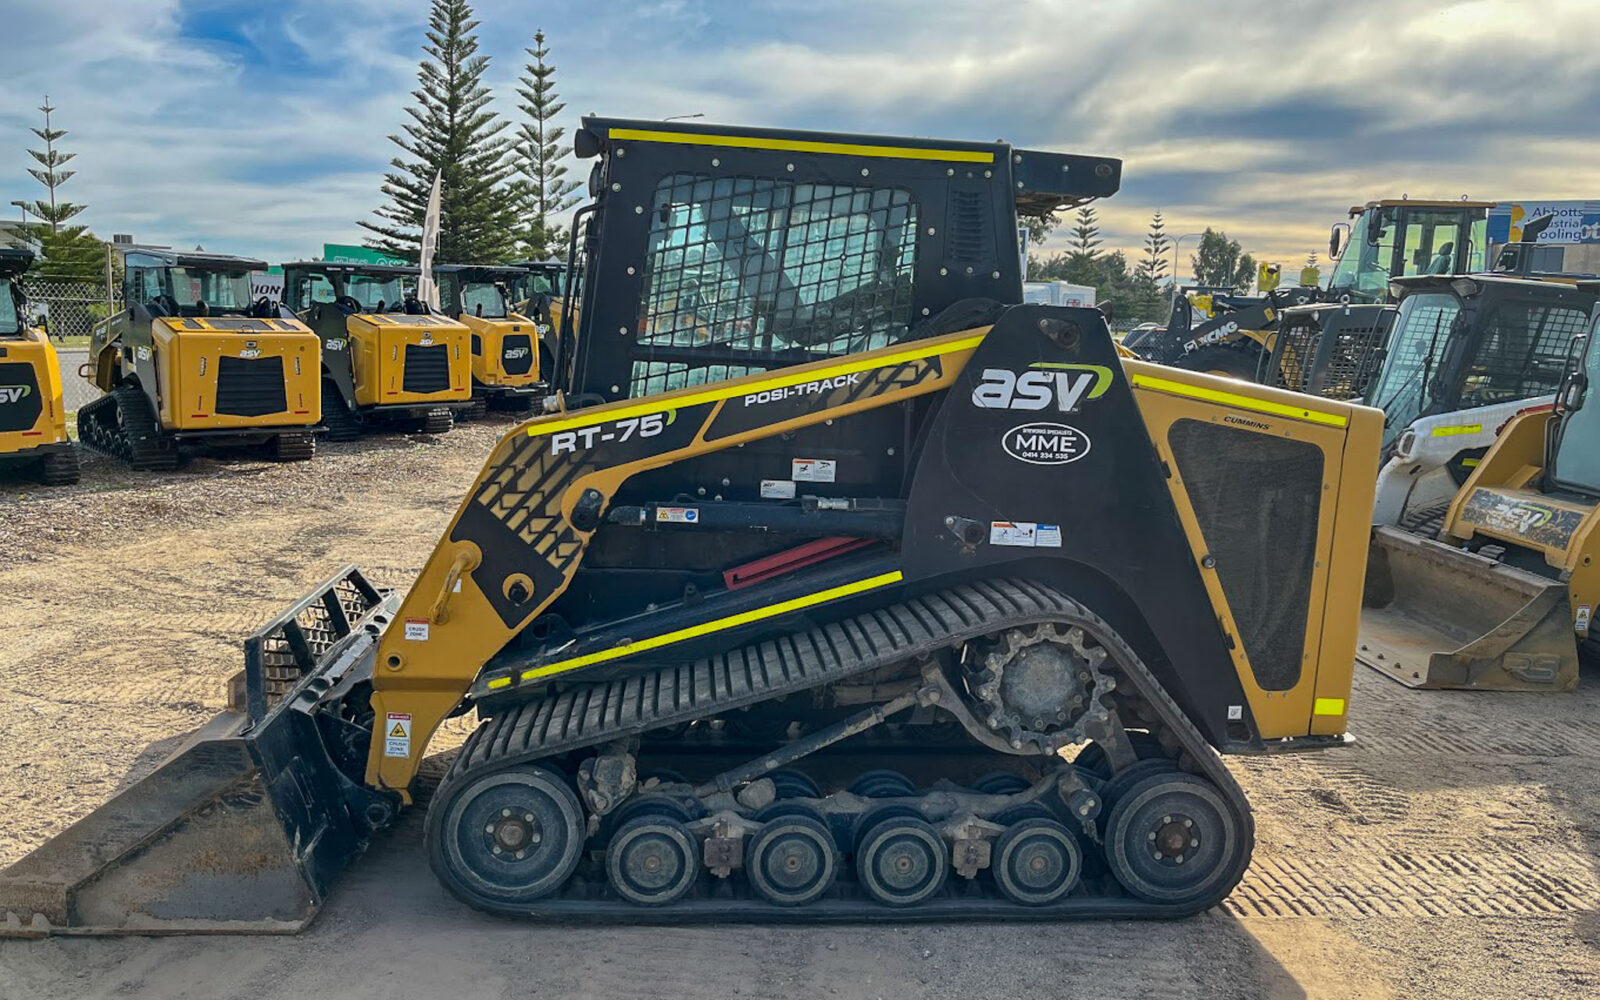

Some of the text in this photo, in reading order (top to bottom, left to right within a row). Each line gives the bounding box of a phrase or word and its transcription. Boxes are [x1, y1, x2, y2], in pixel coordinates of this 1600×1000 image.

[1532, 207, 1584, 217] Abbotts
[1536, 229, 1581, 242] ooling
[504, 349, 525, 359] asv
[744, 373, 859, 407] POSI-TRACK
[972, 368, 1094, 412] asv
[1224, 416, 1270, 430] CUMMINS
[551, 413, 663, 456] RT-75
[1015, 434, 1078, 453] MME
